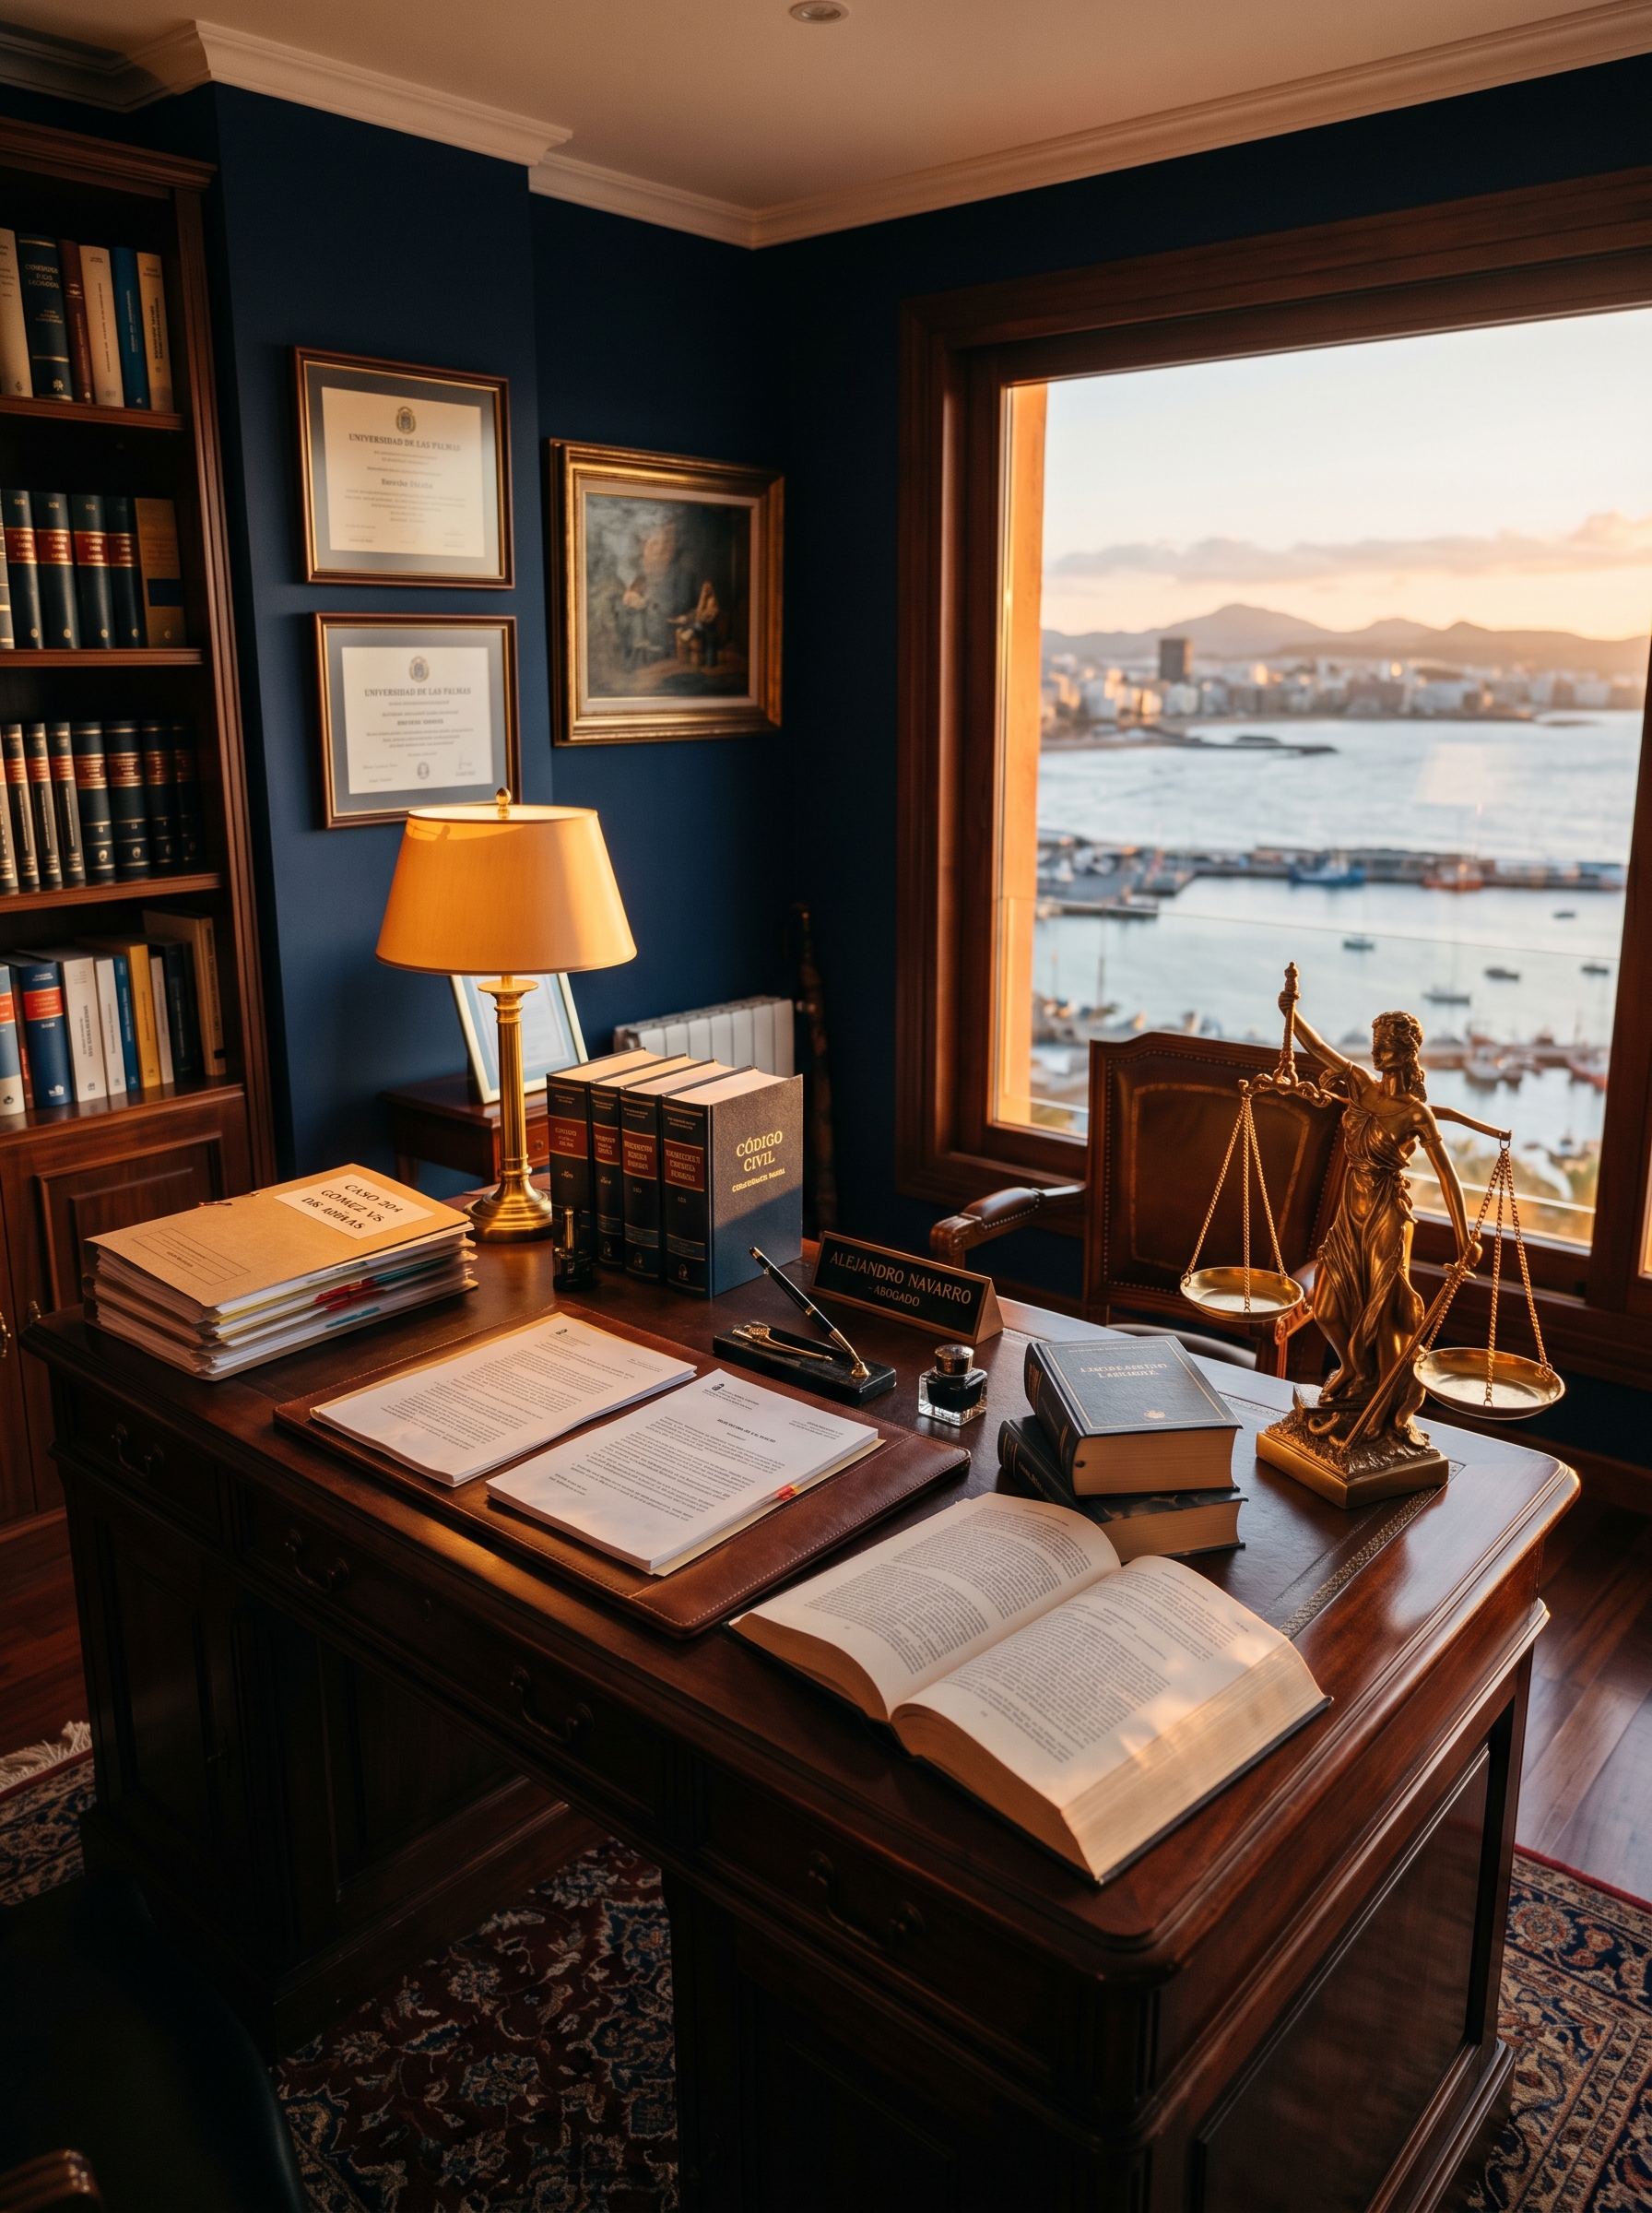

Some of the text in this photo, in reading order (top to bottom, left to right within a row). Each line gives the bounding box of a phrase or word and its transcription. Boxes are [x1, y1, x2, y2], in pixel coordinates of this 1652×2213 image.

[405, 439, 414, 447] DE
[736, 1130, 783, 1157] CÓDIGO
[743, 1150, 775, 1172] CIVIL
[321, 1189, 368, 1213] GOMEZ
[344, 1184, 380, 1201] CASO
[830, 1251, 972, 1305] ALEJANDRO NAVARRO
[874, 1285, 920, 1307] ABOGADO
